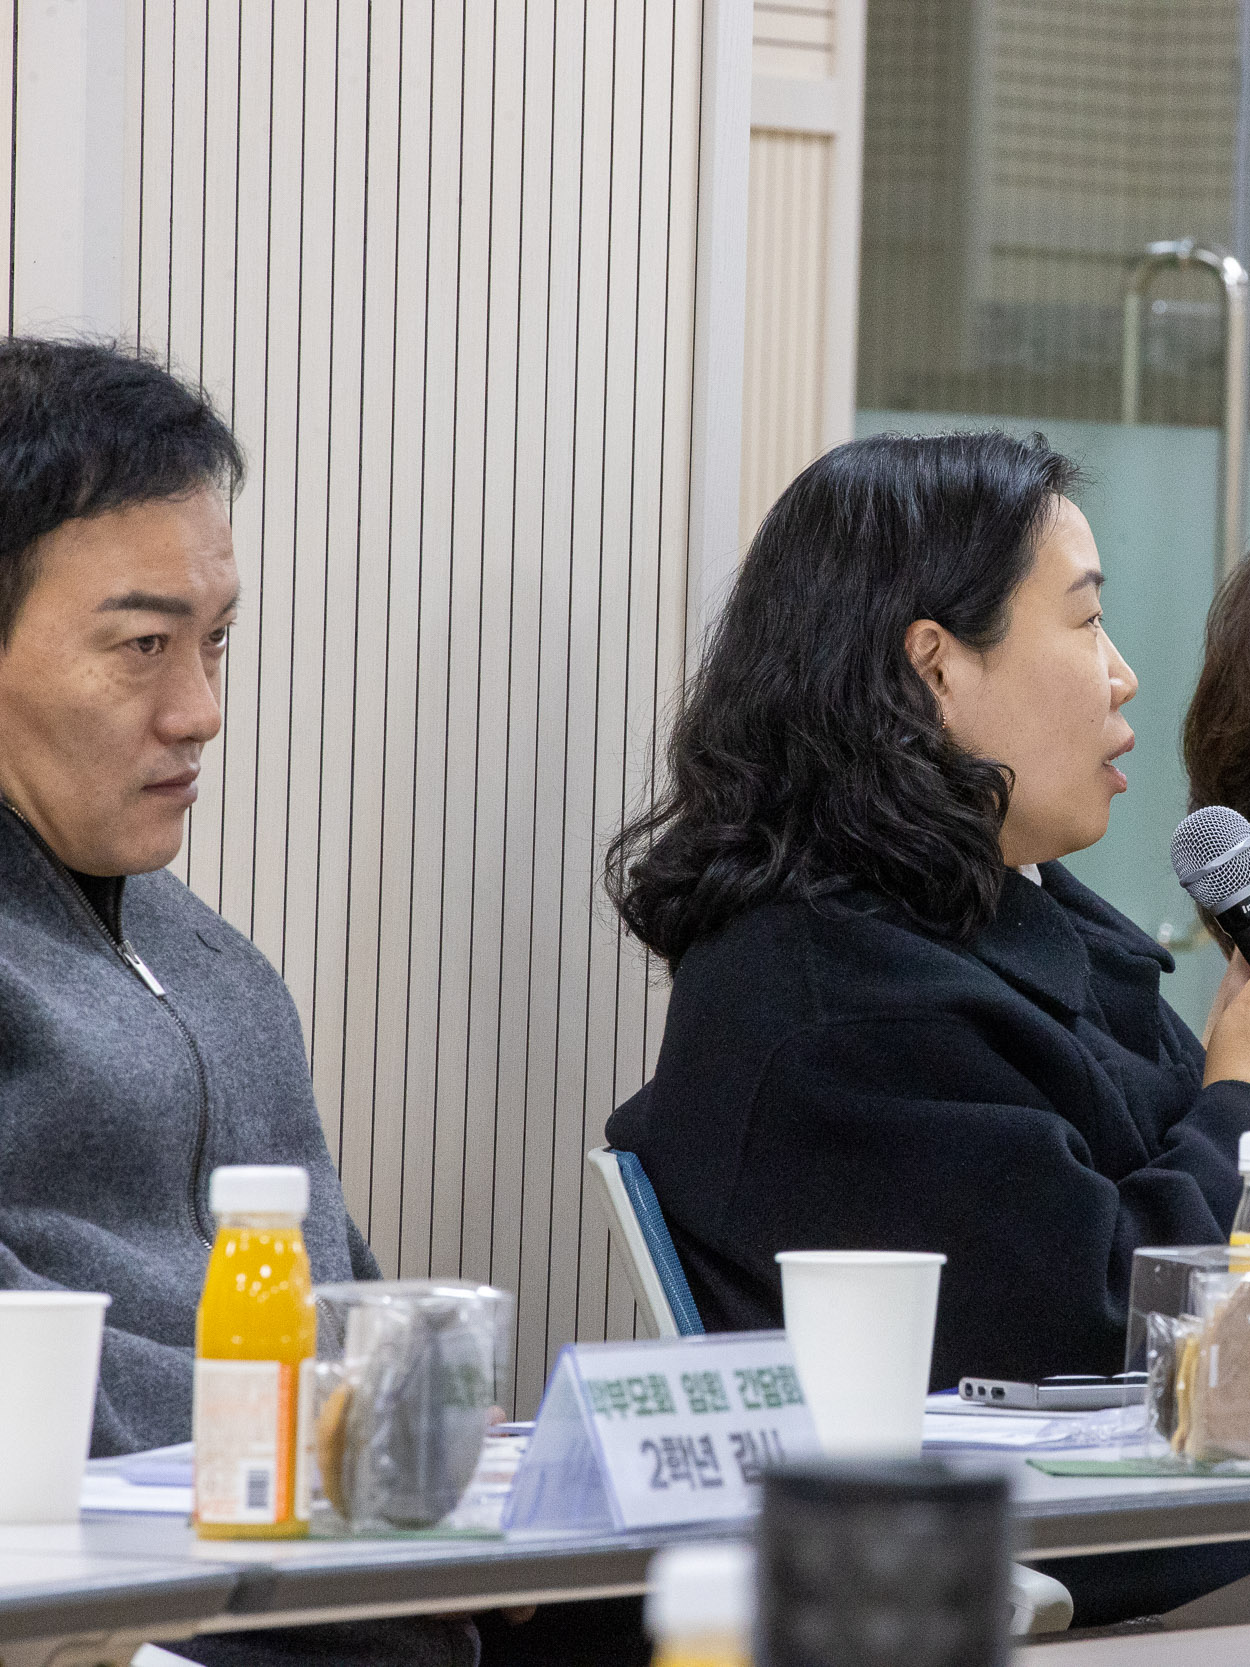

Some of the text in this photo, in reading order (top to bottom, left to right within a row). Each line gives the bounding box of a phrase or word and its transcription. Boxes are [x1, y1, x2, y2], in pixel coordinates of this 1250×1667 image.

[680, 1370, 730, 1415] 임원
[733, 1365, 805, 1410] 간담회
[639, 1433, 723, 1490] 2학년
